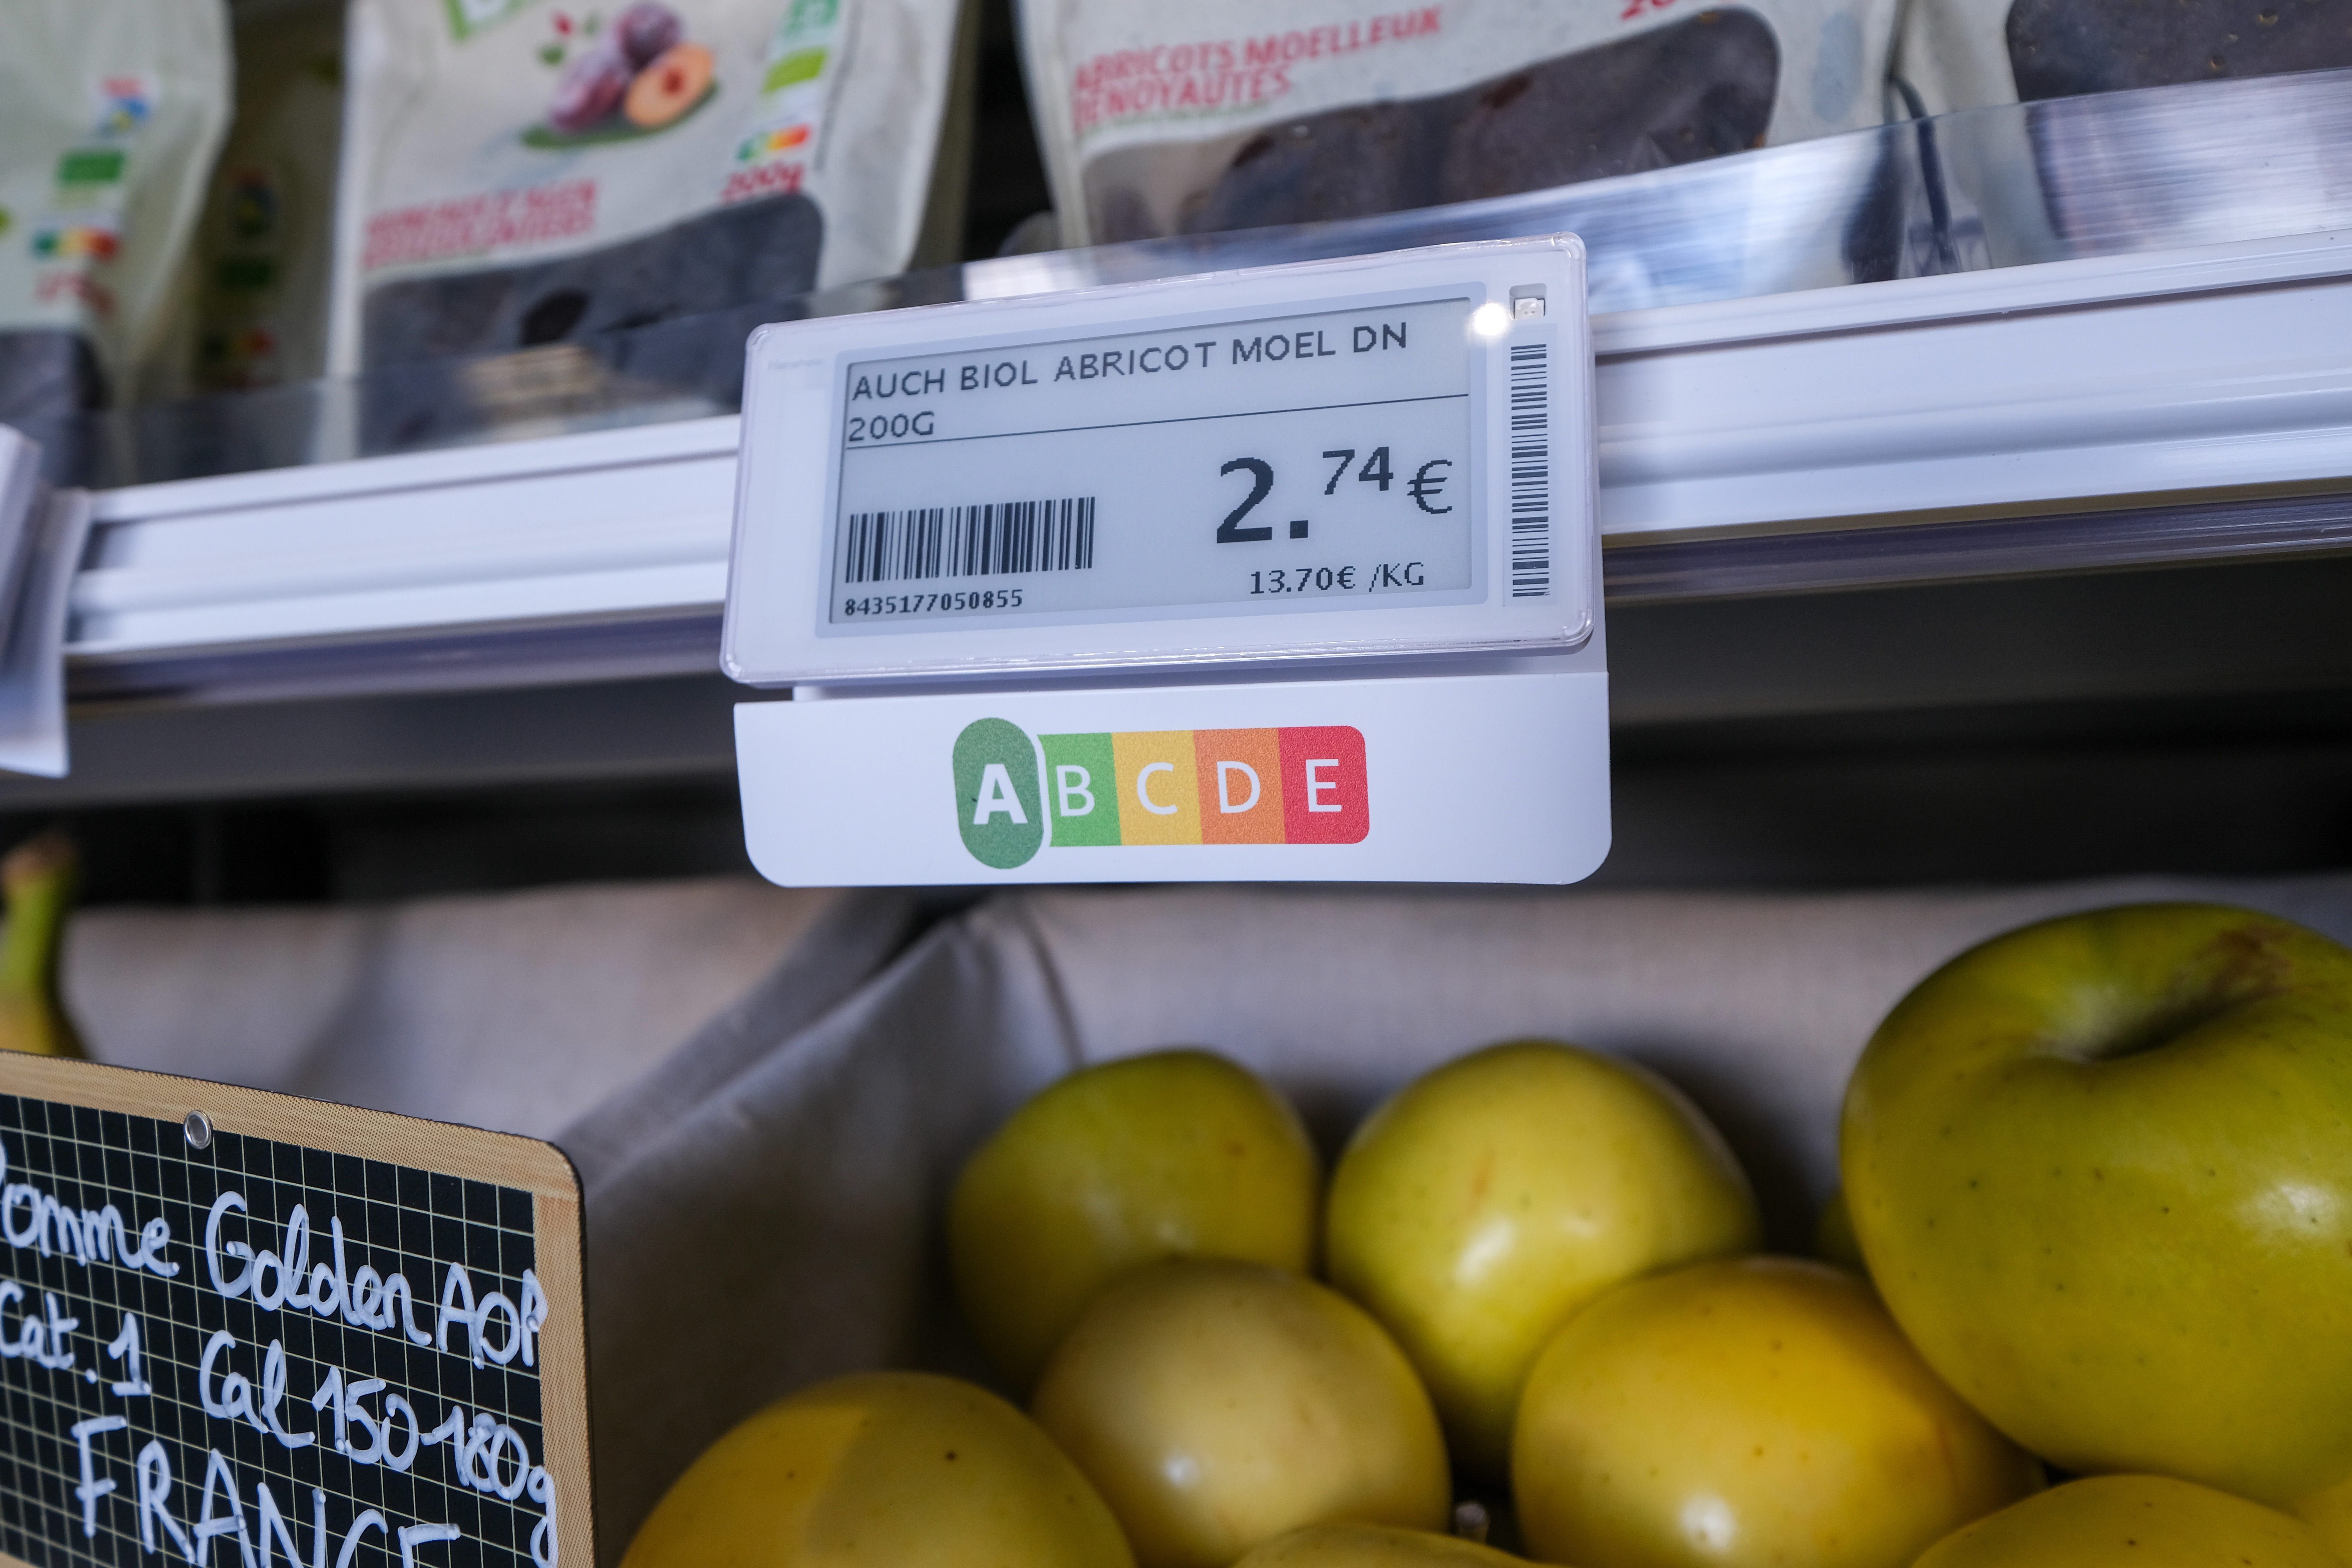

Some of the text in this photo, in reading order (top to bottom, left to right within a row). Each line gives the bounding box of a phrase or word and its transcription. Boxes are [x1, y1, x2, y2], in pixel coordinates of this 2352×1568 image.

[851, 322, 1407, 401] AUCH BIOL ABRICOT MOEL DN
[849, 411, 934, 442] 200G
[845, 589, 1023, 616] 8435177050855
[1250, 562, 1424, 594] 13.70€ /KG
[0, 1138, 548, 1370] omme Golden AOP
[200, 1330, 315, 1448] Cal
